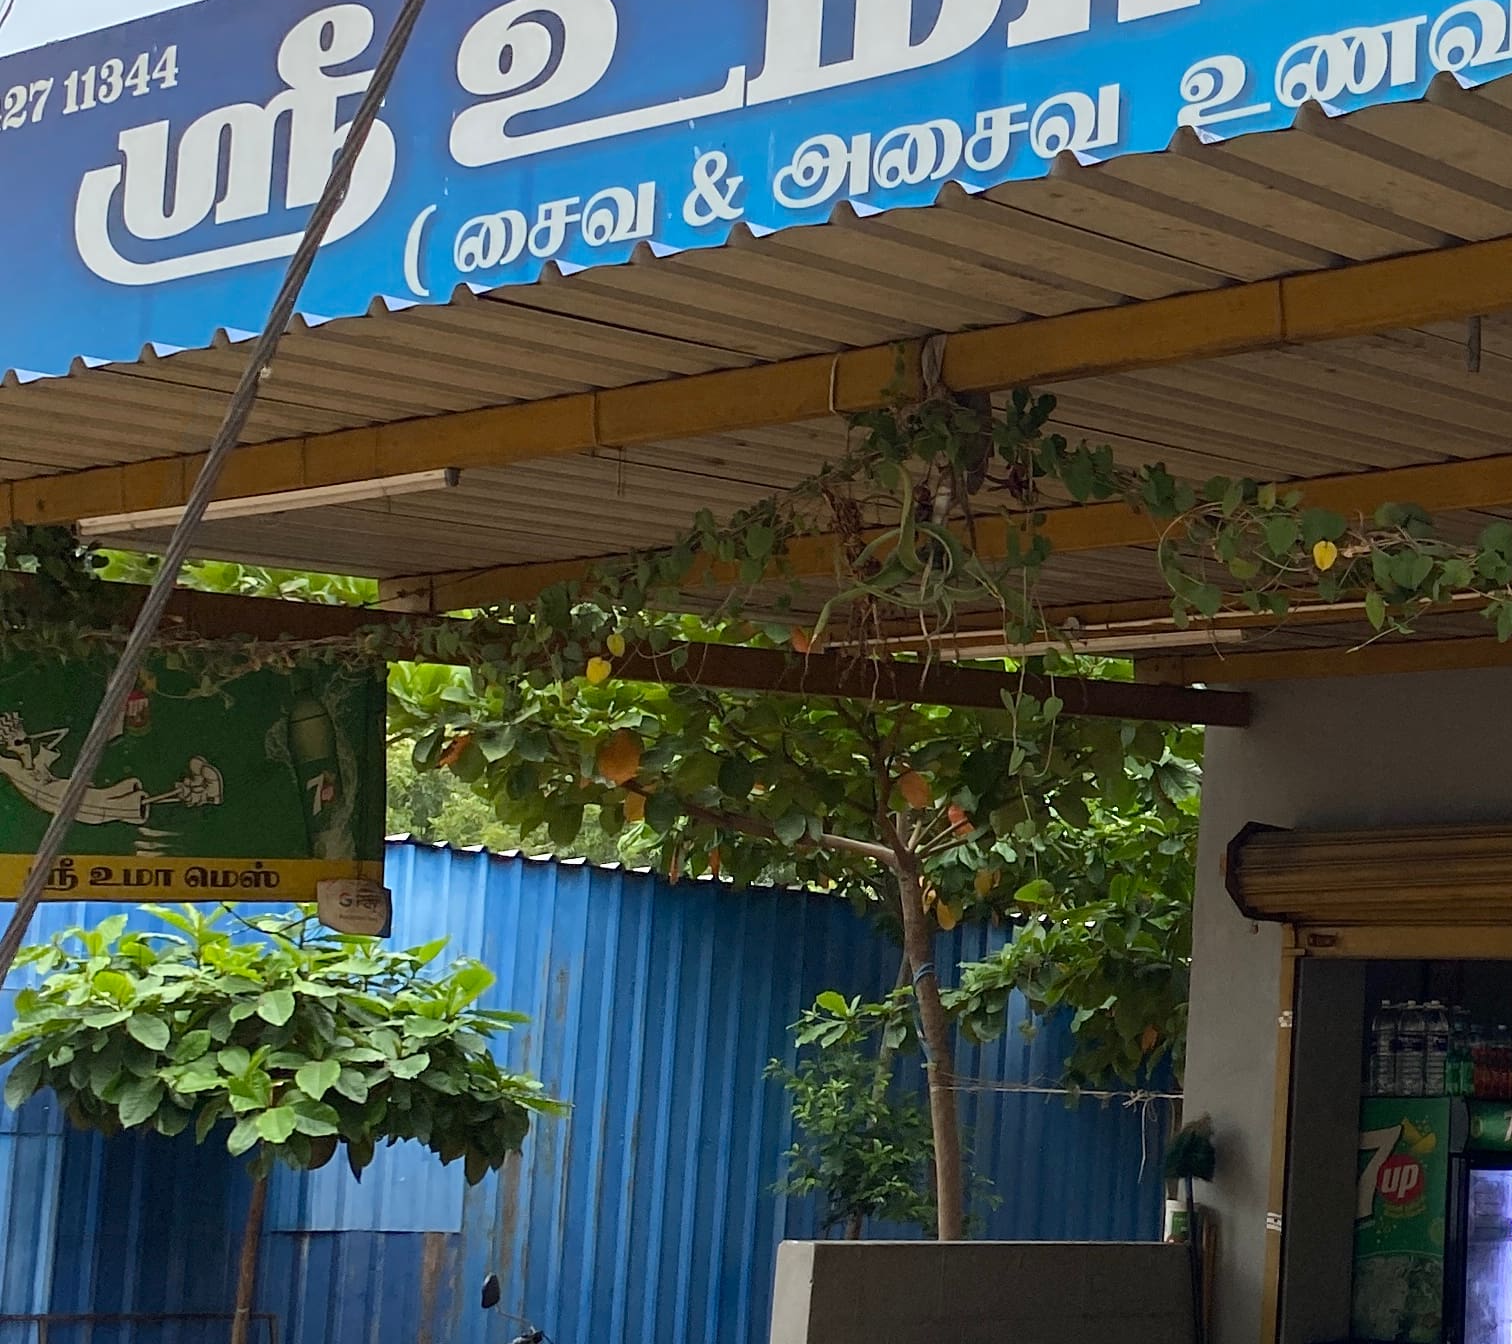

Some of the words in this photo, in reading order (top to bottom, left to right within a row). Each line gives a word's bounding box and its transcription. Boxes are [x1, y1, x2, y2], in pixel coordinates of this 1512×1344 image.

[0, 77, 55, 132] 27
[62, 45, 179, 115] 11344
[682, 150, 745, 228] &
[772, 83, 1122, 210] அசைவ
[89, 866, 176, 887] உமா
[184, 861, 281, 888] மெஸ்
